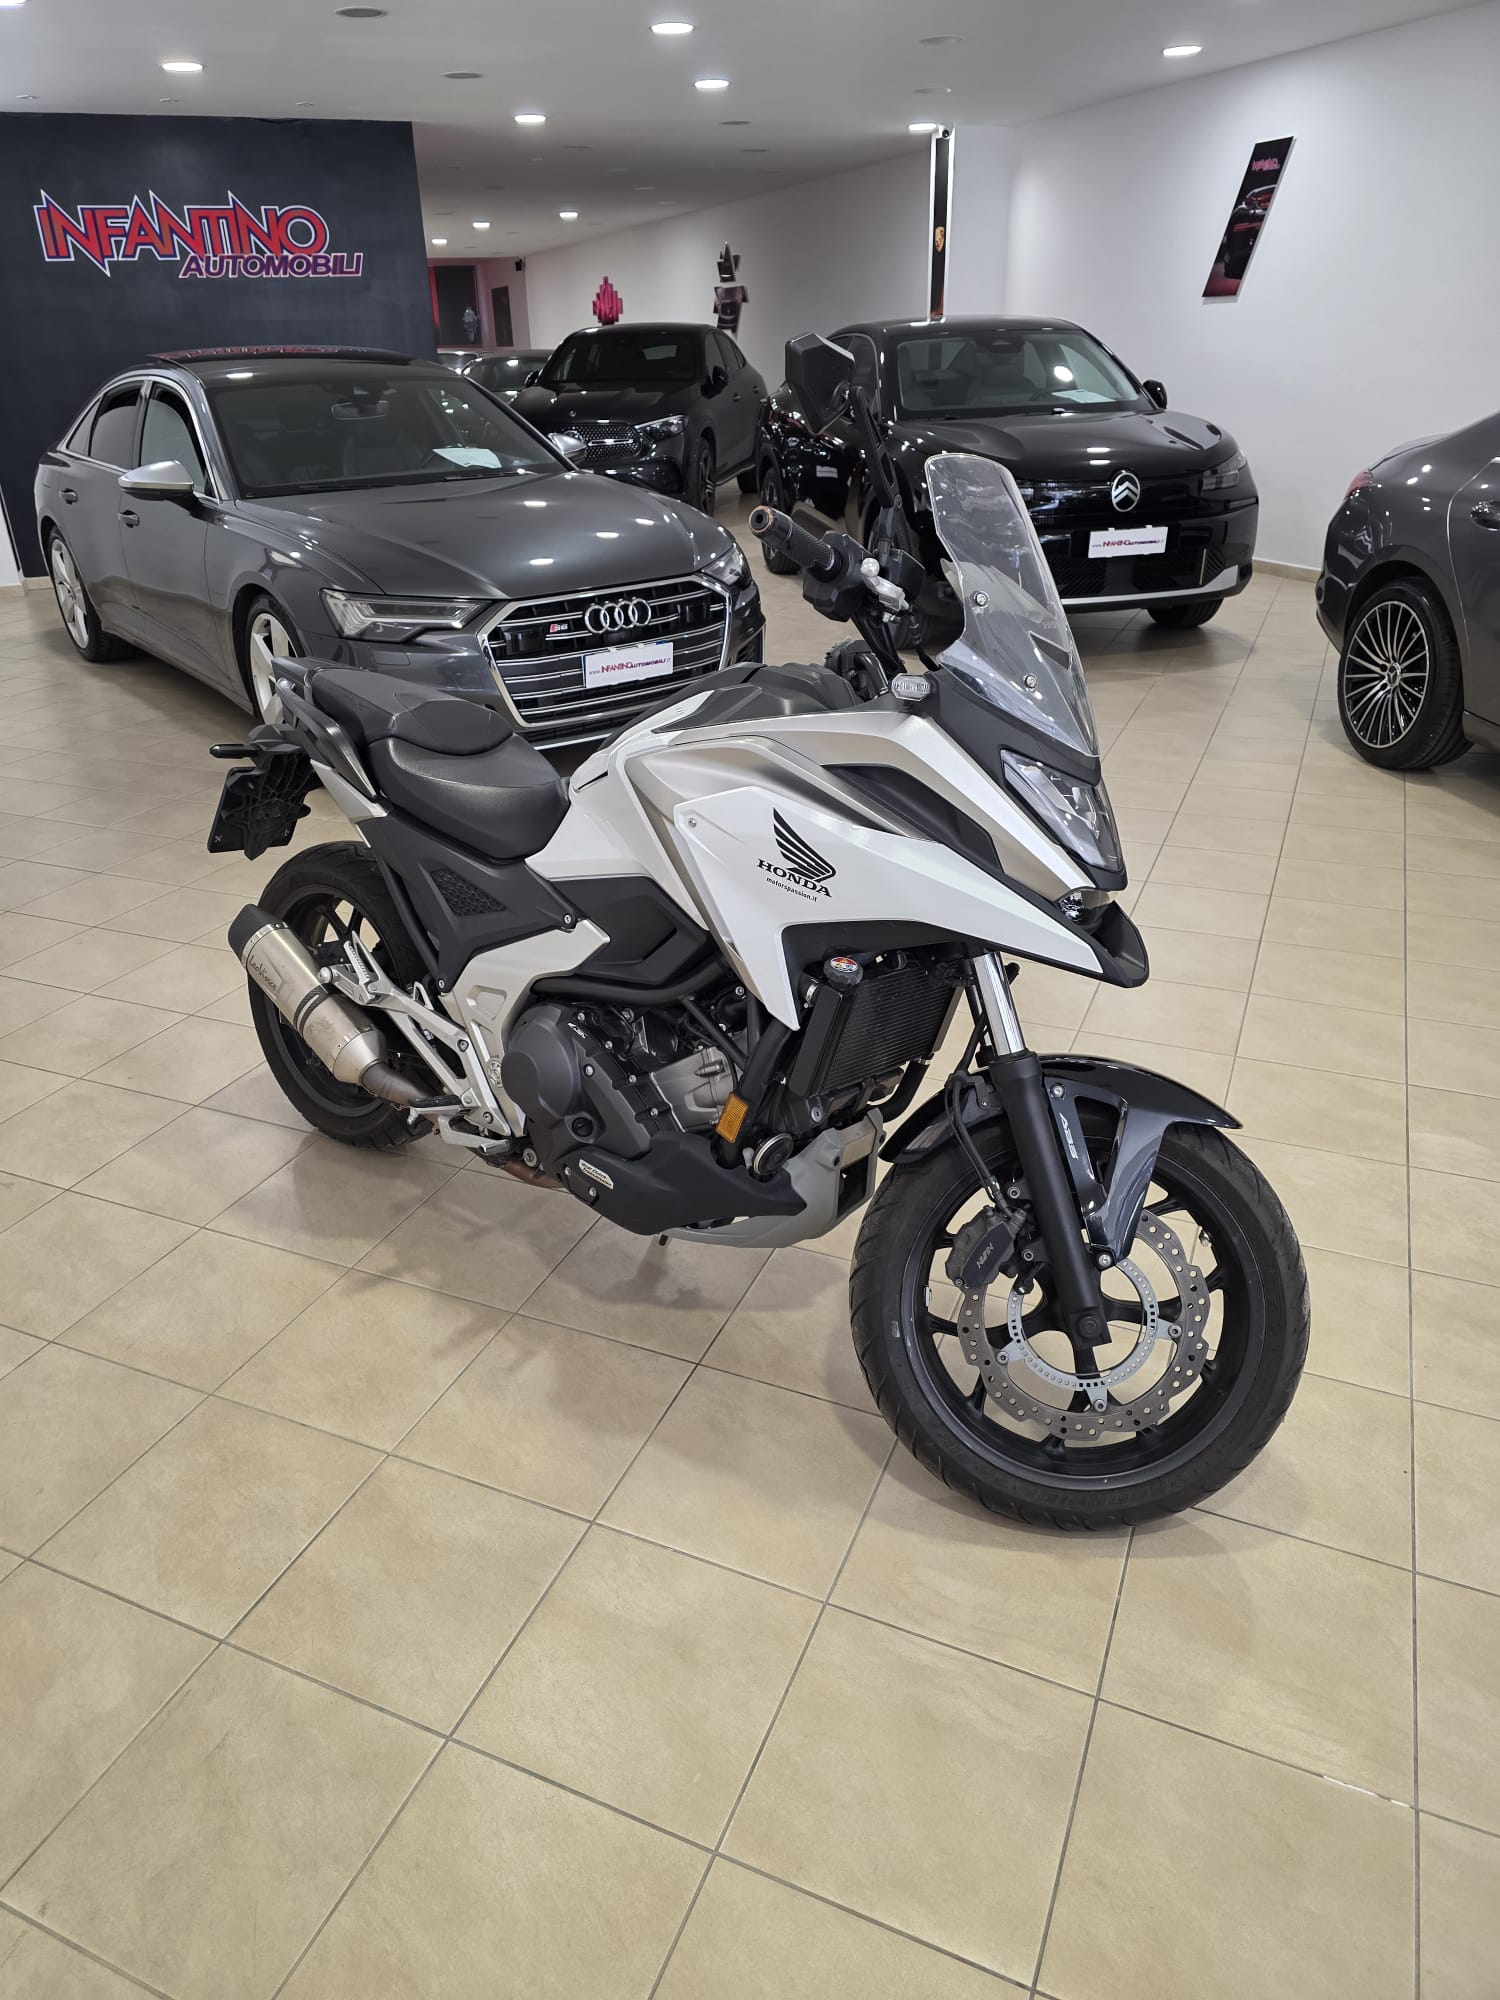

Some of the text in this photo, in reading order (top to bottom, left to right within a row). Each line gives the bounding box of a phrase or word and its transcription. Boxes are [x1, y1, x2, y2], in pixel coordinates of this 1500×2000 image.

[33, 189, 330, 277] INFANTINO
[179, 252, 363, 278] AUTOMOBILI
[756, 858, 832, 898] HONDA
[766, 877, 818, 902] motorspassion.it
[1059, 1112, 1079, 1159] ABS
